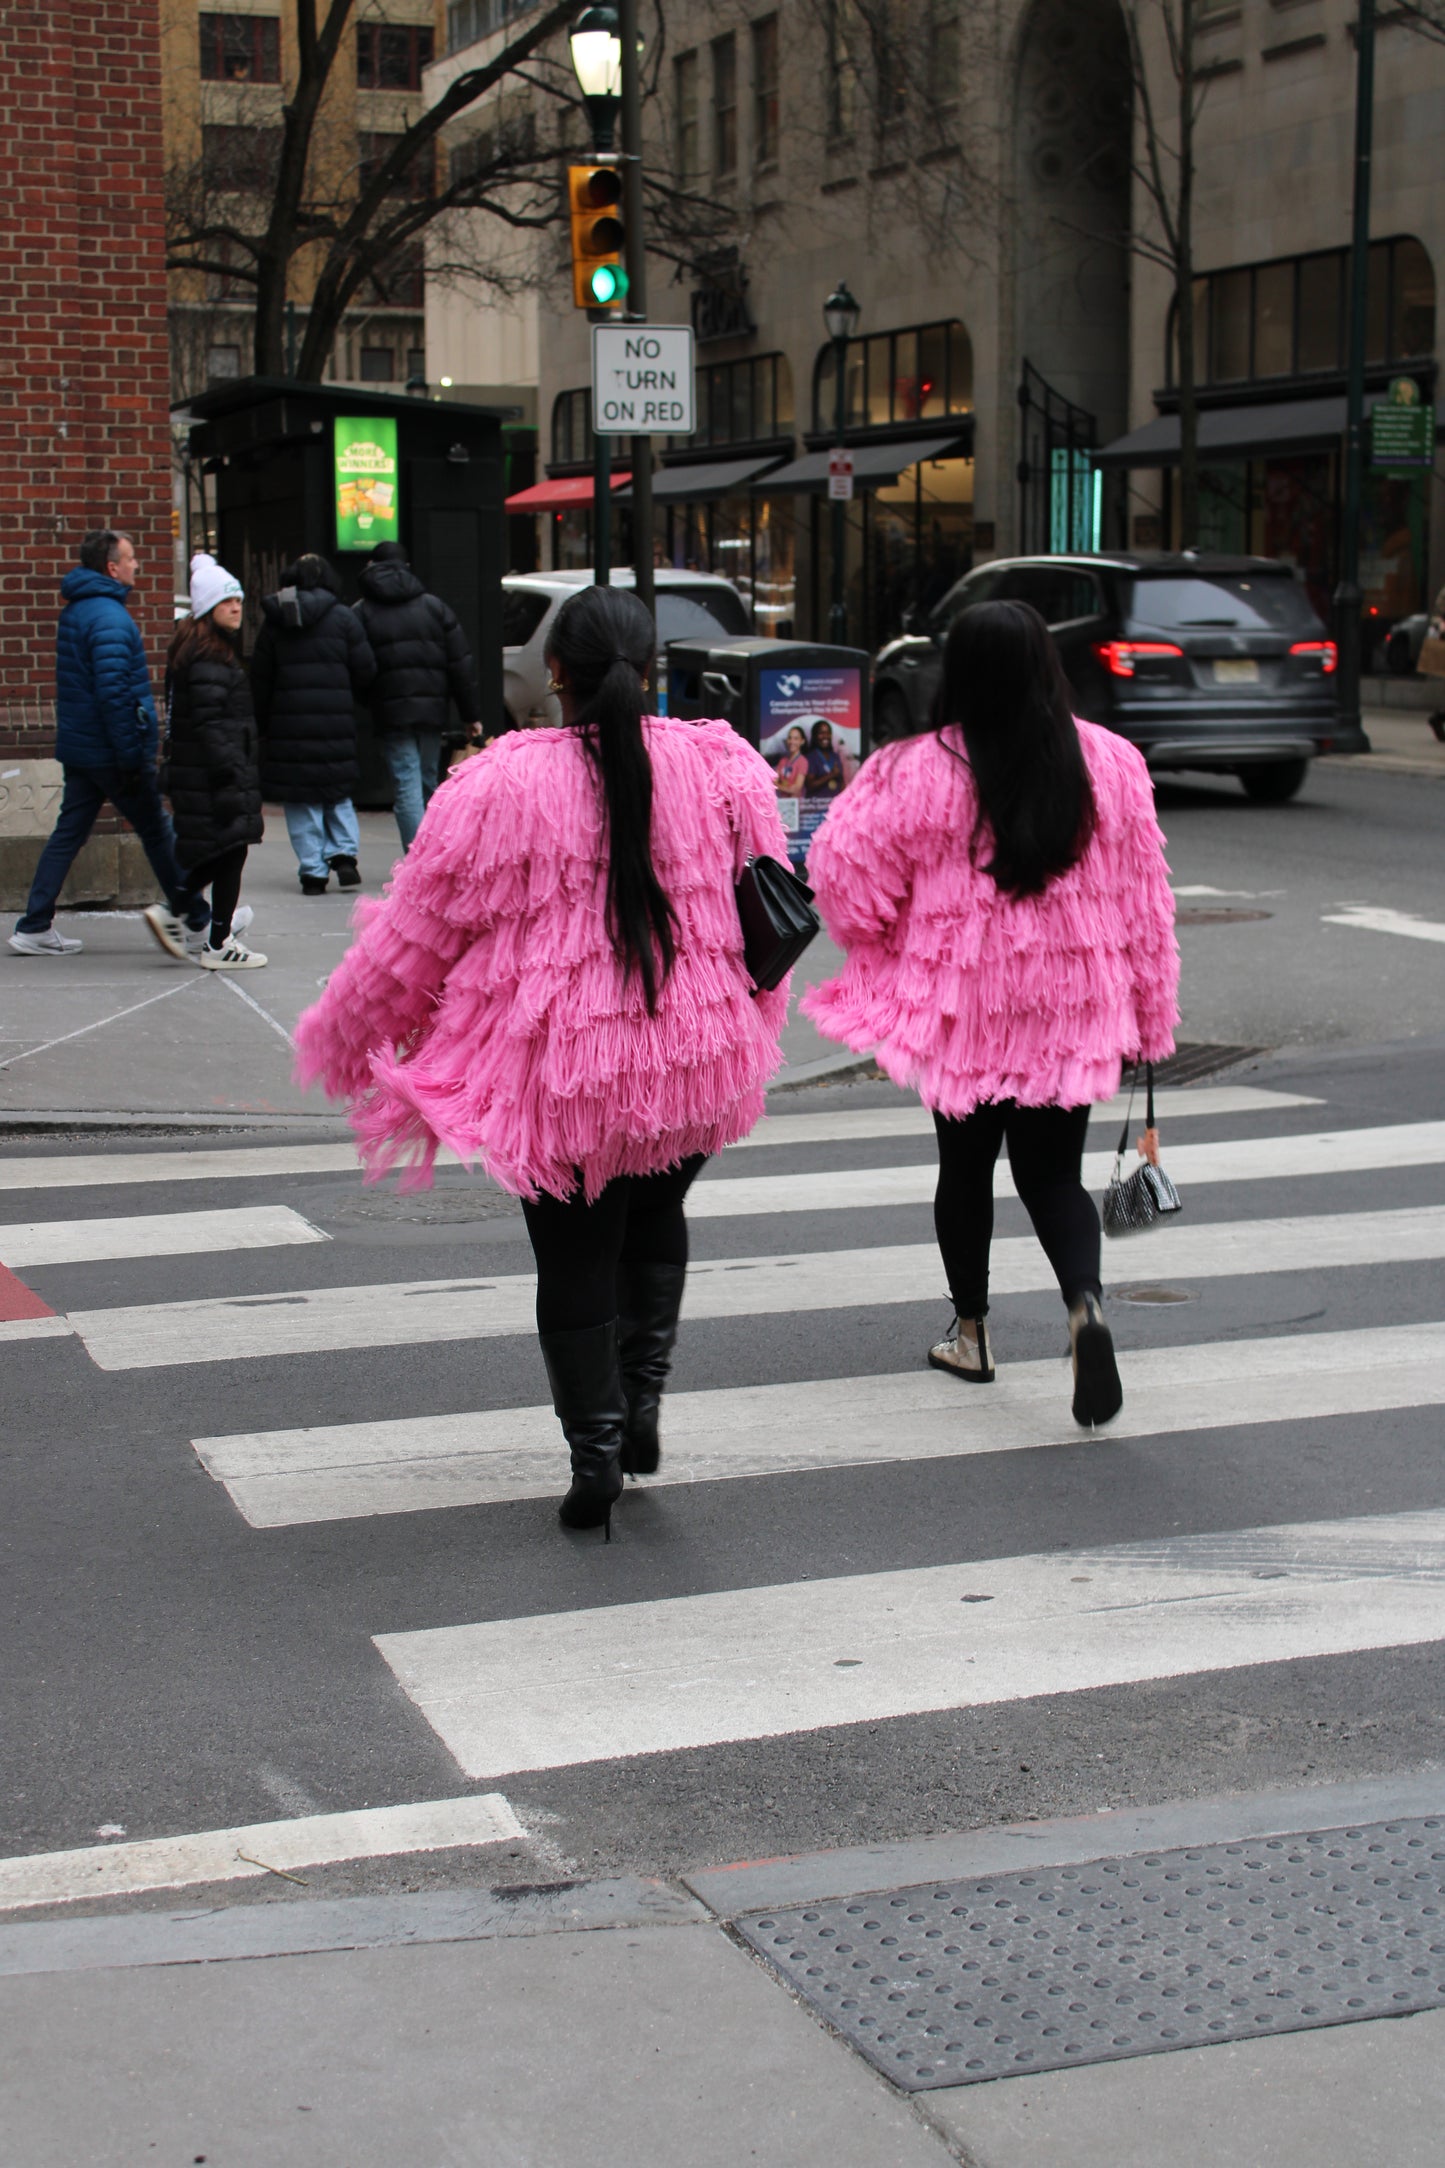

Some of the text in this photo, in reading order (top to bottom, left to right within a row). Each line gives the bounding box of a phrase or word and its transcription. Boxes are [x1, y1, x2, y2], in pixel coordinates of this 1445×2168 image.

[625, 338, 661, 359] NO
[613, 369, 676, 390] TURN
[603, 401, 684, 421] ON RED
